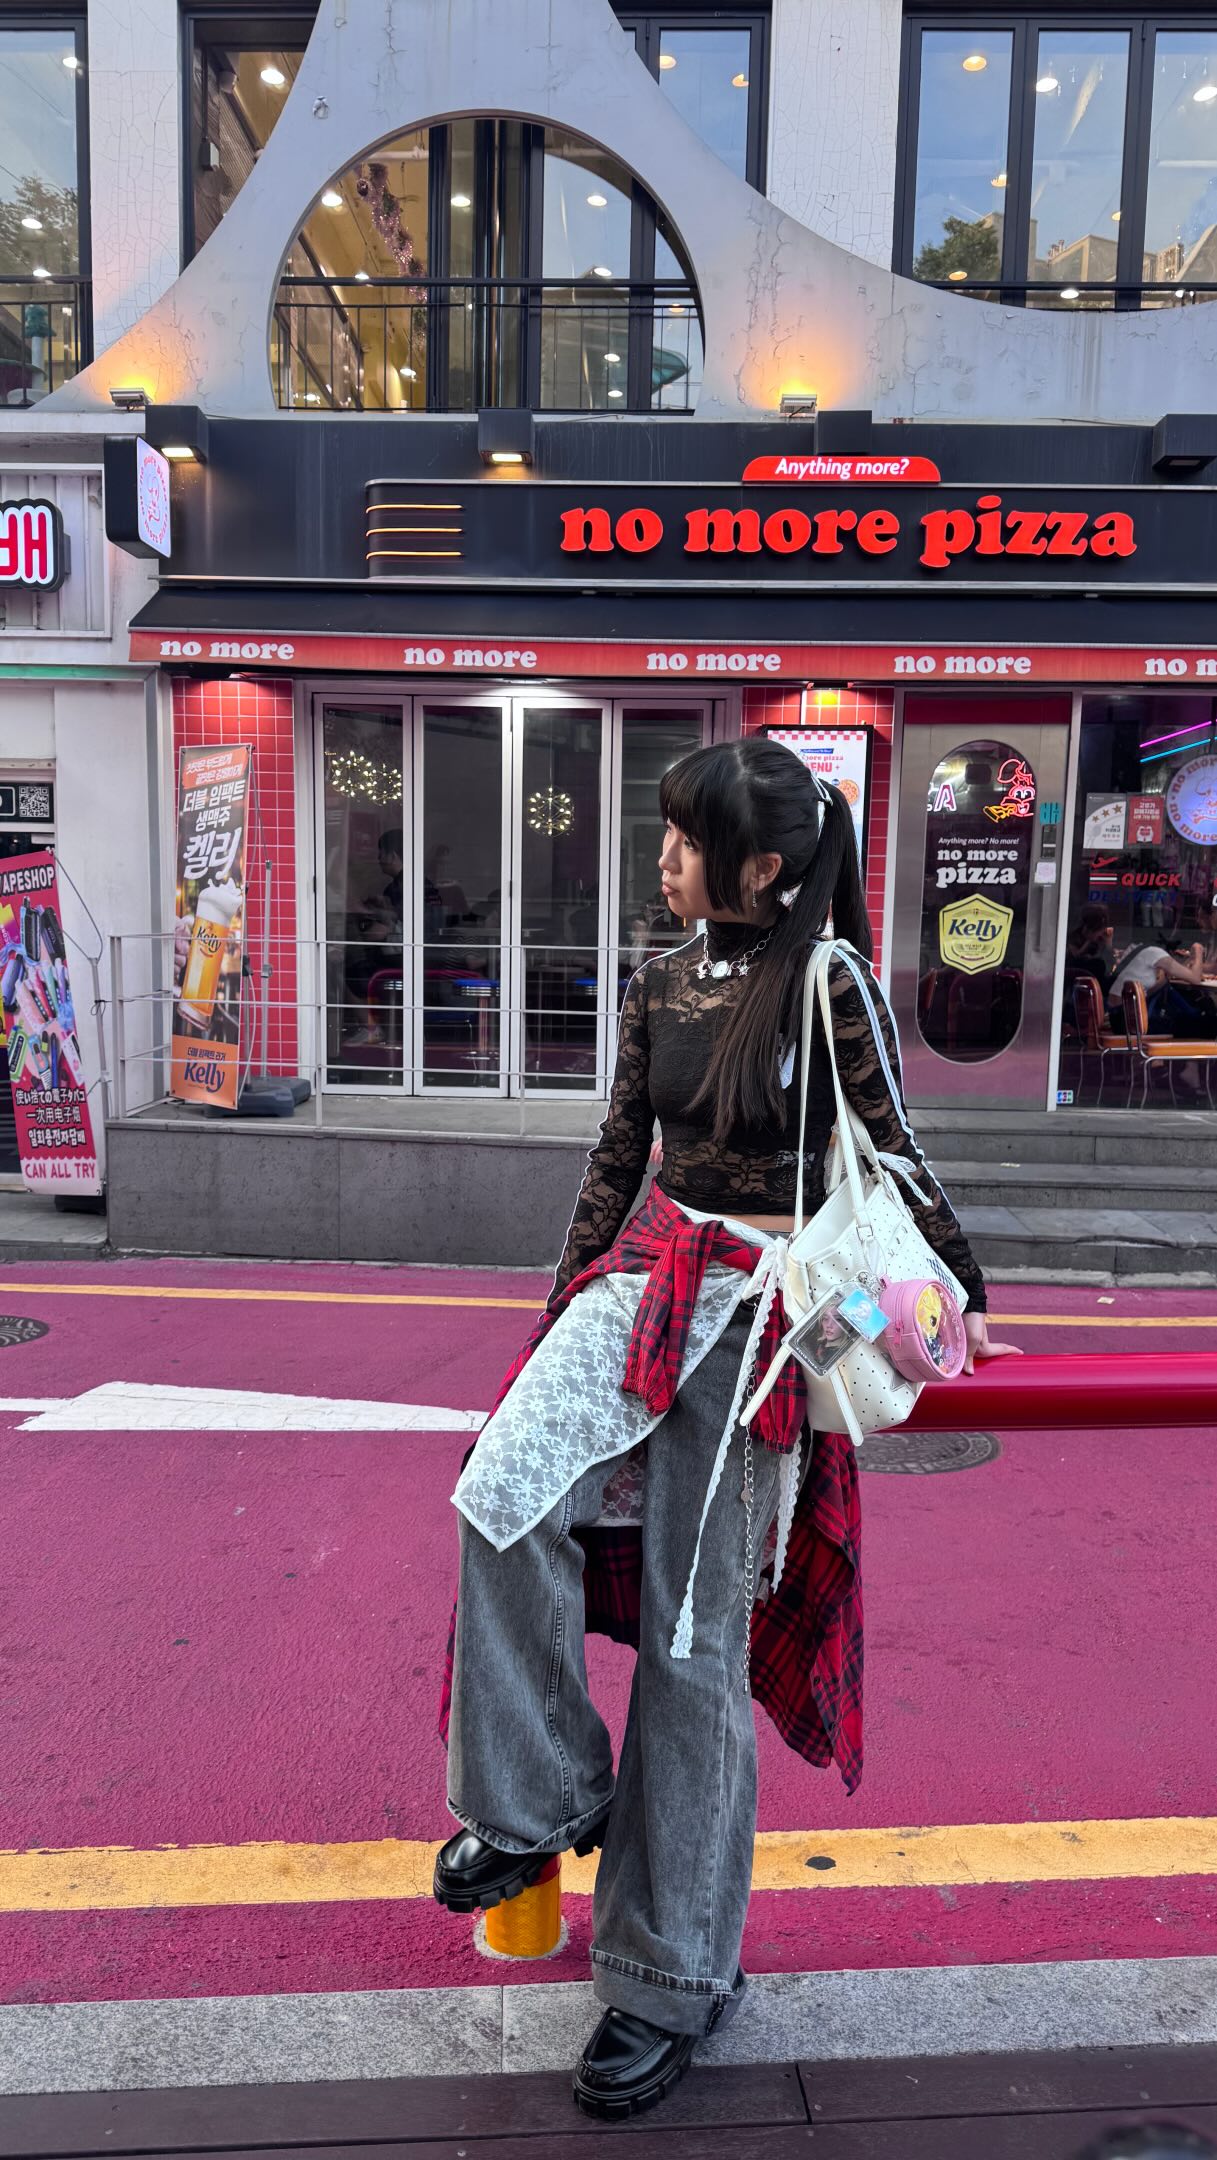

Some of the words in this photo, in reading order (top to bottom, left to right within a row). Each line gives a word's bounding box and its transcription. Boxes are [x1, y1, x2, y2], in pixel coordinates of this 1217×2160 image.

[775, 457, 852, 481] Anything
[855, 458, 910, 475] more?
[560, 507, 664, 553] no
[683, 508, 900, 554] more
[919, 494, 1137, 568] pizza
[160, 640, 202, 657] no
[209, 641, 295, 660] more
[404, 647, 445, 665] no
[452, 648, 538, 668] more
[646, 652, 688, 671] no
[695, 653, 782, 672] more
[893, 655, 937, 674] no
[943, 655, 1032, 675] more
[1144, 657, 1188, 676] no
[182, 787, 208, 813] 더블
[208, 779, 246, 807] 임팩트
[195, 805, 232, 832] 생맥주
[938, 837, 968, 846] Anything
[968, 837, 989, 845] more?
[989, 837, 1000, 845] No
[1000, 837, 1020, 845] more!
[183, 826, 242, 880] 켈리
[937, 849, 962, 861] no
[967, 849, 1018, 861] more
[0, 864, 55, 894] APESHOP
[936, 862, 1017, 889] pizza
[1121, 873, 1182, 887] QUICK
[197, 926, 222, 953] Kelly
[948, 918, 1003, 942] Kelly
[184, 1058, 225, 1093] Kelly
[28, 1127, 86, 1148] 일회용전자담배
[24, 1162, 47, 1179] CAN
[50, 1162, 72, 1179] ALL
[74, 1162, 96, 1179] TRY
